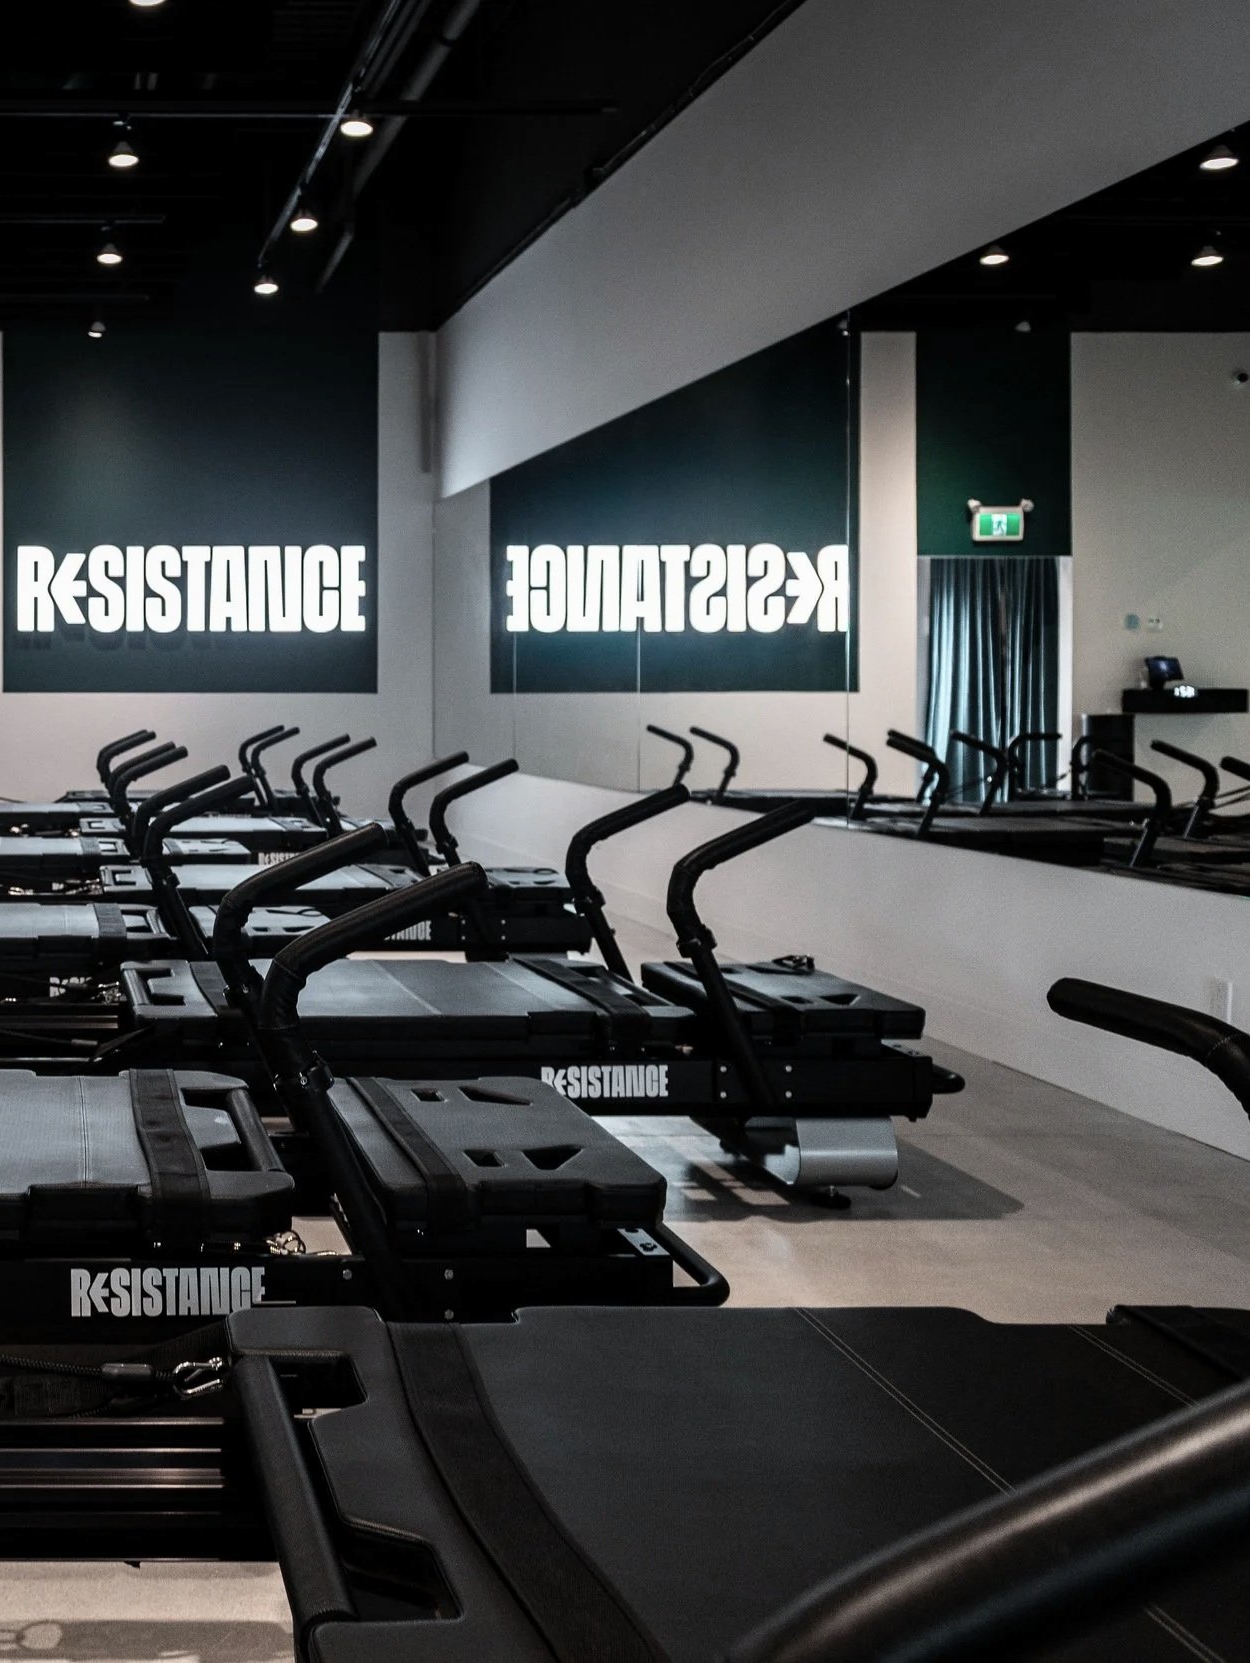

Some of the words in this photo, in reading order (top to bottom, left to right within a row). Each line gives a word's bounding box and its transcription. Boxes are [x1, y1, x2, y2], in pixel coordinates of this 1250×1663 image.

[17, 544, 366, 633] RESISTANCE
[541, 1065, 669, 1098] RESISTANCE
[70, 1266, 265, 1317] RESISTANCE
